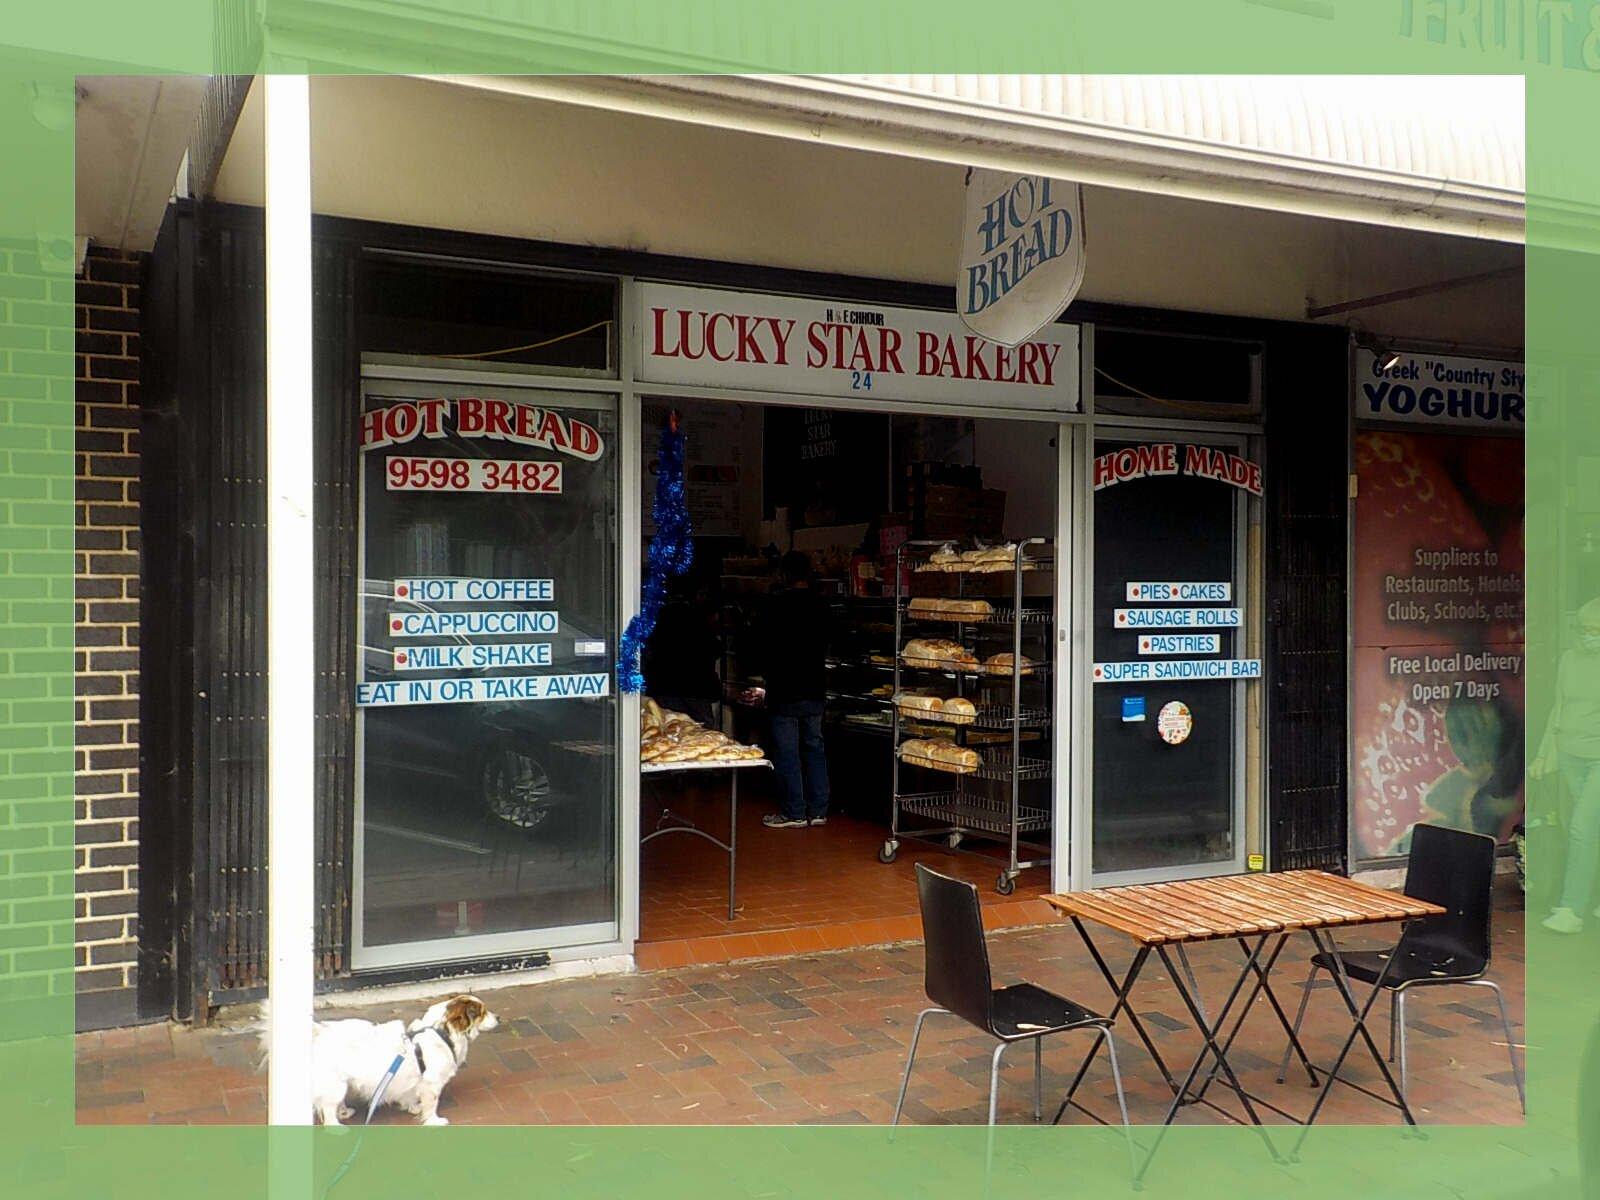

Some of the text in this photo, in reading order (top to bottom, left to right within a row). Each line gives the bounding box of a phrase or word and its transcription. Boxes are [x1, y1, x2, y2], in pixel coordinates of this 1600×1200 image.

[977, 175, 1054, 256] HOT
[964, 208, 1073, 315] BREAD
[651, 307, 1061, 386] LUCKY STAR BAKERY
[852, 371, 871, 390] 24
[1372, 358, 1419, 380] Greek
[360, 398, 604, 461] HOT BREAD
[388, 458, 560, 492] 9598 3482
[1094, 444, 1263, 497] HOME MADE
[1415, 547, 1498, 570] Suppliers to
[409, 580, 552, 600] HOT COFFEE
[1140, 584, 1225, 599] PIES CAKES
[1385, 575, 1474, 596] Restaurants,
[404, 612, 555, 634] CAPPUCCINO
[1127, 610, 1238, 625] SAUSAGE ROLLS
[1387, 600, 1431, 623] Clubs,
[1434, 600, 1490, 622] Schools,
[1151, 636, 1214, 651] PASTRIES
[408, 644, 549, 667] MILK SHAKE
[1390, 652, 1521, 674] Free Local Delivery
[1103, 661, 1259, 679] SUPER SANDWICH BAR
[357, 675, 606, 704] EAT IN OR TAKE AWAY
[1413, 681, 1500, 704] Open 7 Days
